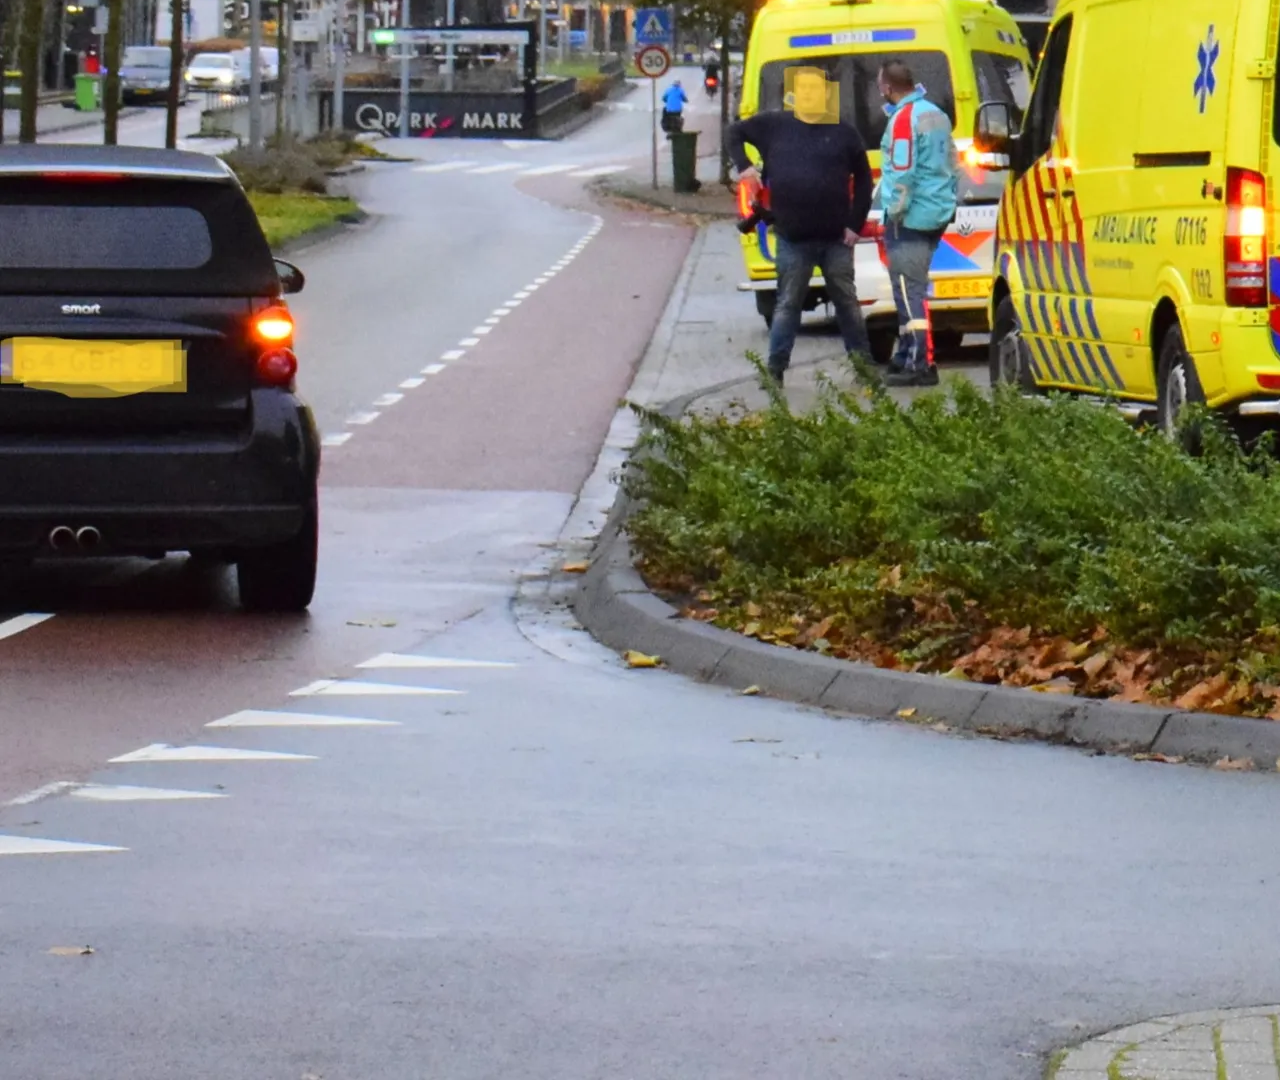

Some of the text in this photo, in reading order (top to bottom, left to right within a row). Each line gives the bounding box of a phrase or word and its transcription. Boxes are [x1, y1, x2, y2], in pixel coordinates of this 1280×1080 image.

[643, 54, 664, 68] 30
[1092, 216, 1208, 245] AMBULANCE 07116
[61, 303, 101, 314] smart
